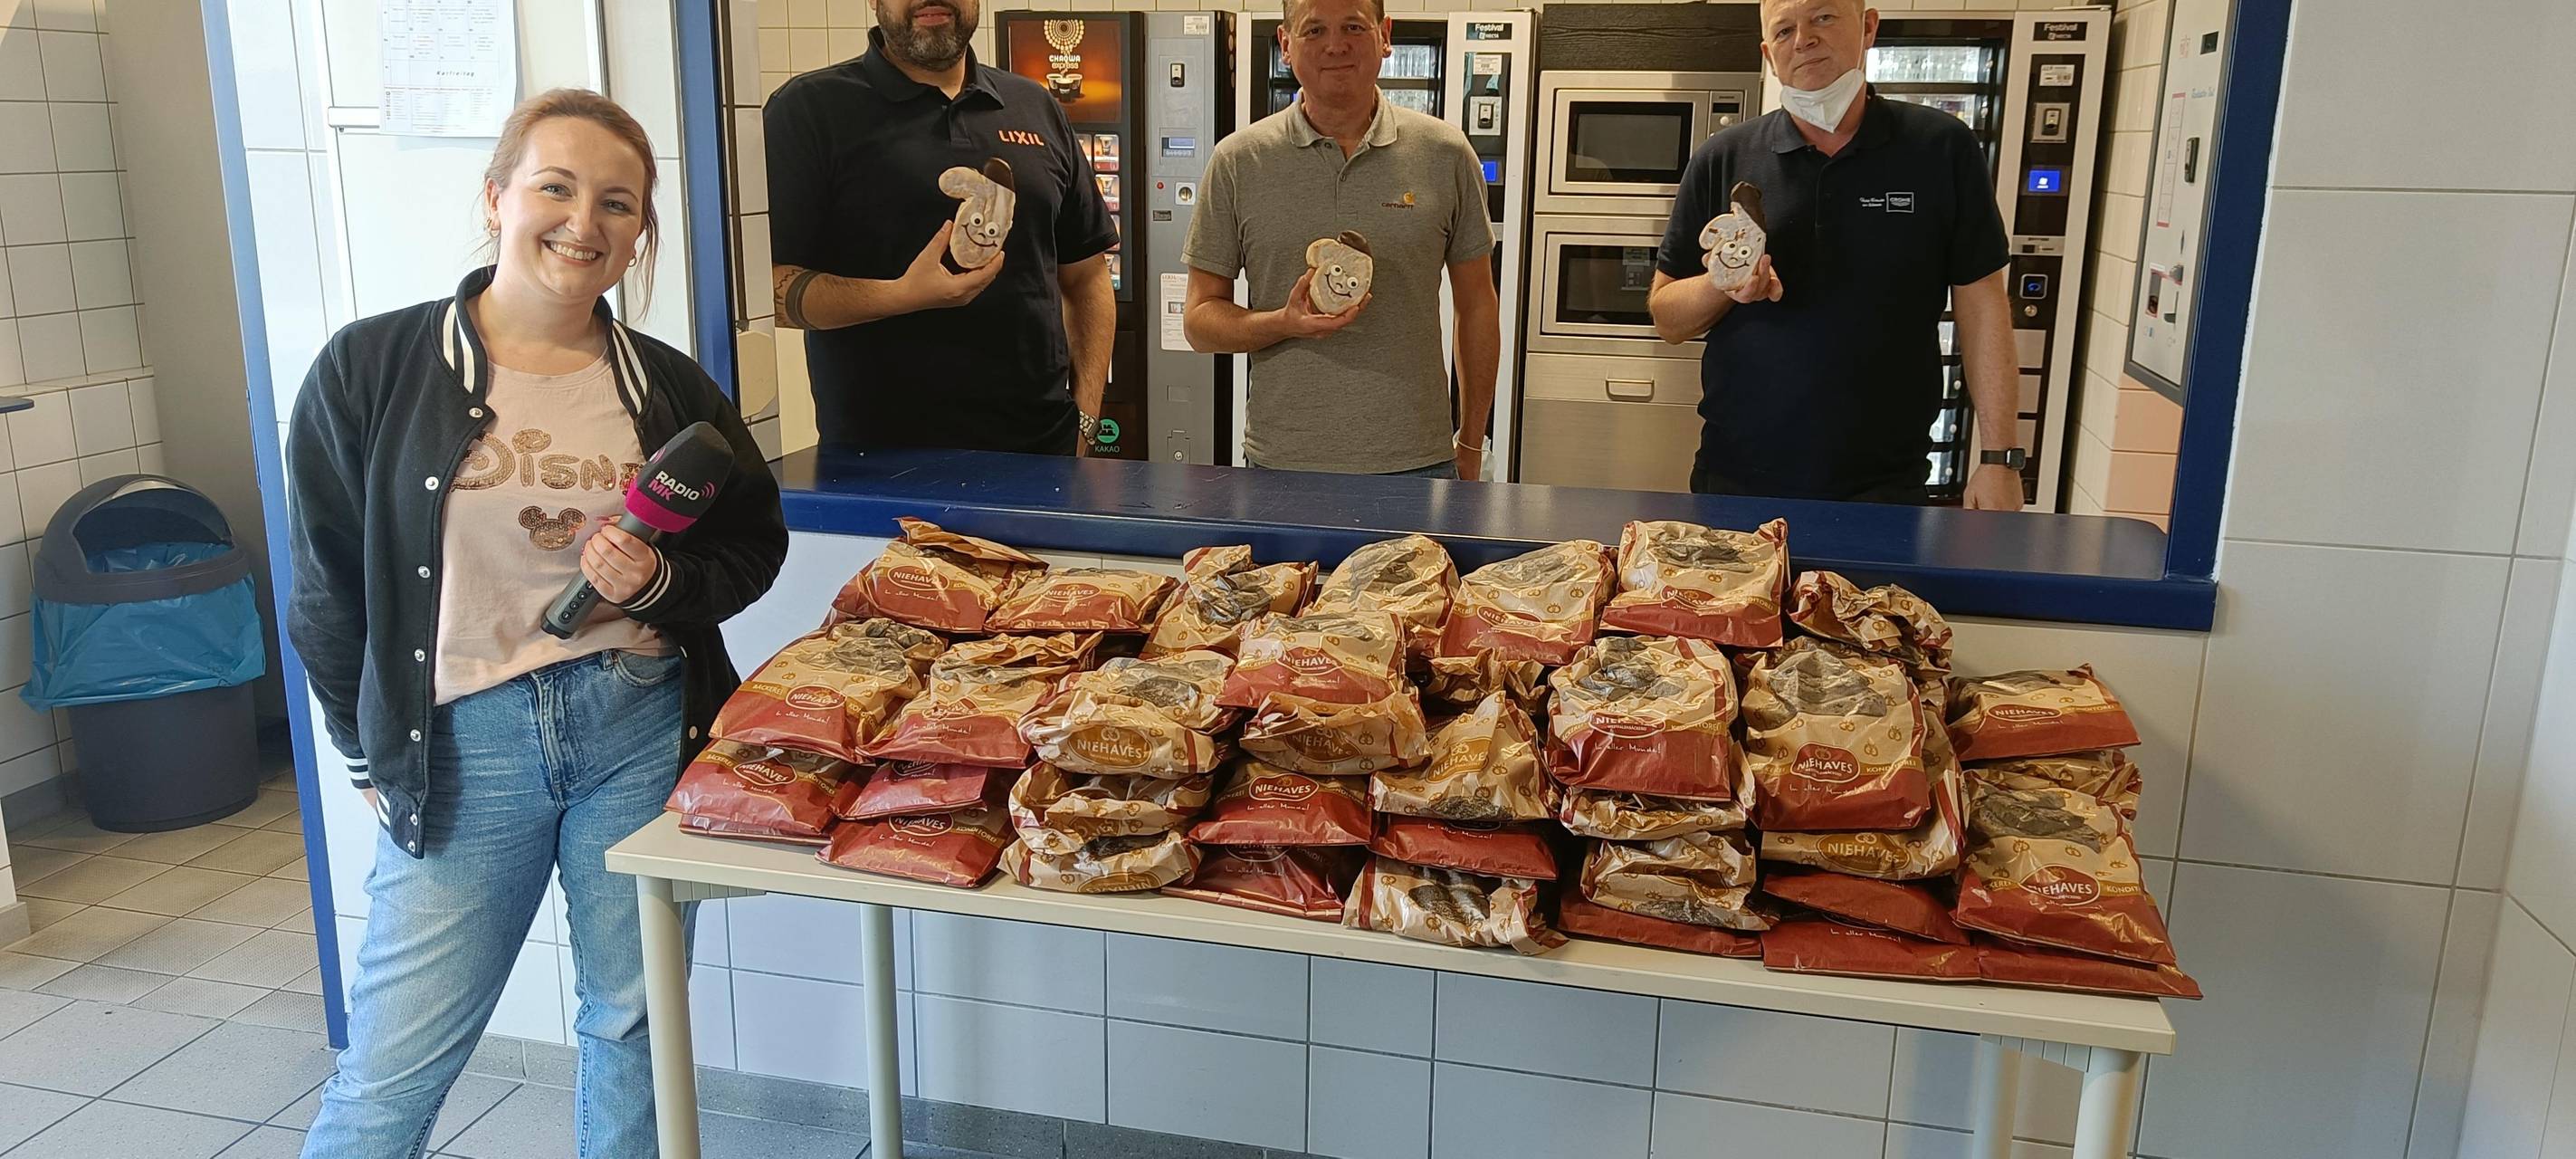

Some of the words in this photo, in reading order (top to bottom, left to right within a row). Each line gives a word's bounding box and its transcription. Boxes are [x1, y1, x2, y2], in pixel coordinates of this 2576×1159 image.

[1474, 23, 1504, 33] Festival
[997, 129, 1045, 147] LIXIL
[1094, 445, 1121, 454] KAKAO
[647, 478, 673, 502] MK
[654, 470, 701, 502] RADIO
[1994, 708, 2056, 717] NIEHAVES
[1076, 740, 1143, 759] NIEHAVES
[1797, 757, 1854, 774] NIEHAVES
[1255, 783, 1312, 795] NIEHAVES
[1827, 841, 1900, 863] NIEHAVES
